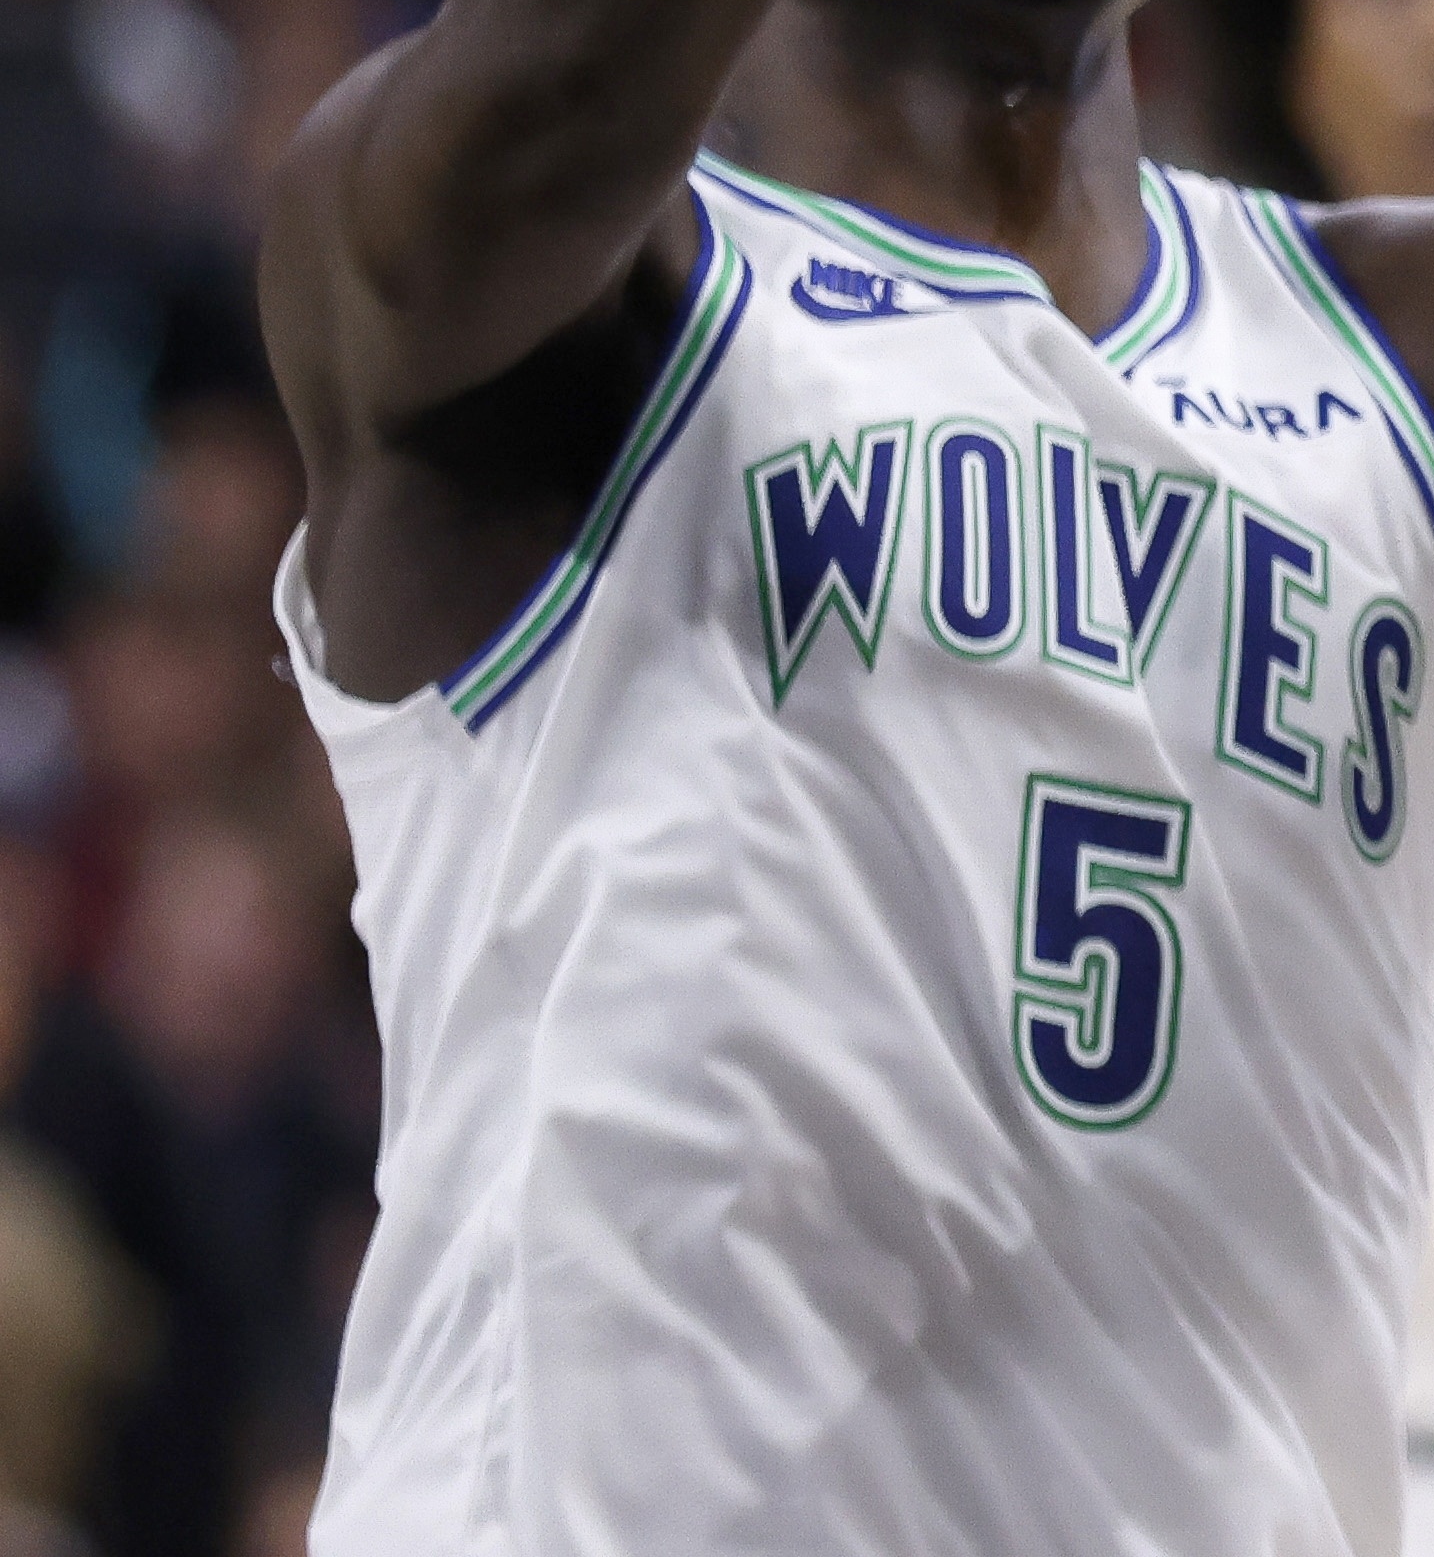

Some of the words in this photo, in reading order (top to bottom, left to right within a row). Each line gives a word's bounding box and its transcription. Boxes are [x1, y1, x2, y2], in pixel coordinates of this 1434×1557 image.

[1170, 388, 1363, 442] AURA
[744, 417, 1425, 867] WOLVES
[1012, 770, 1194, 1132] 5
